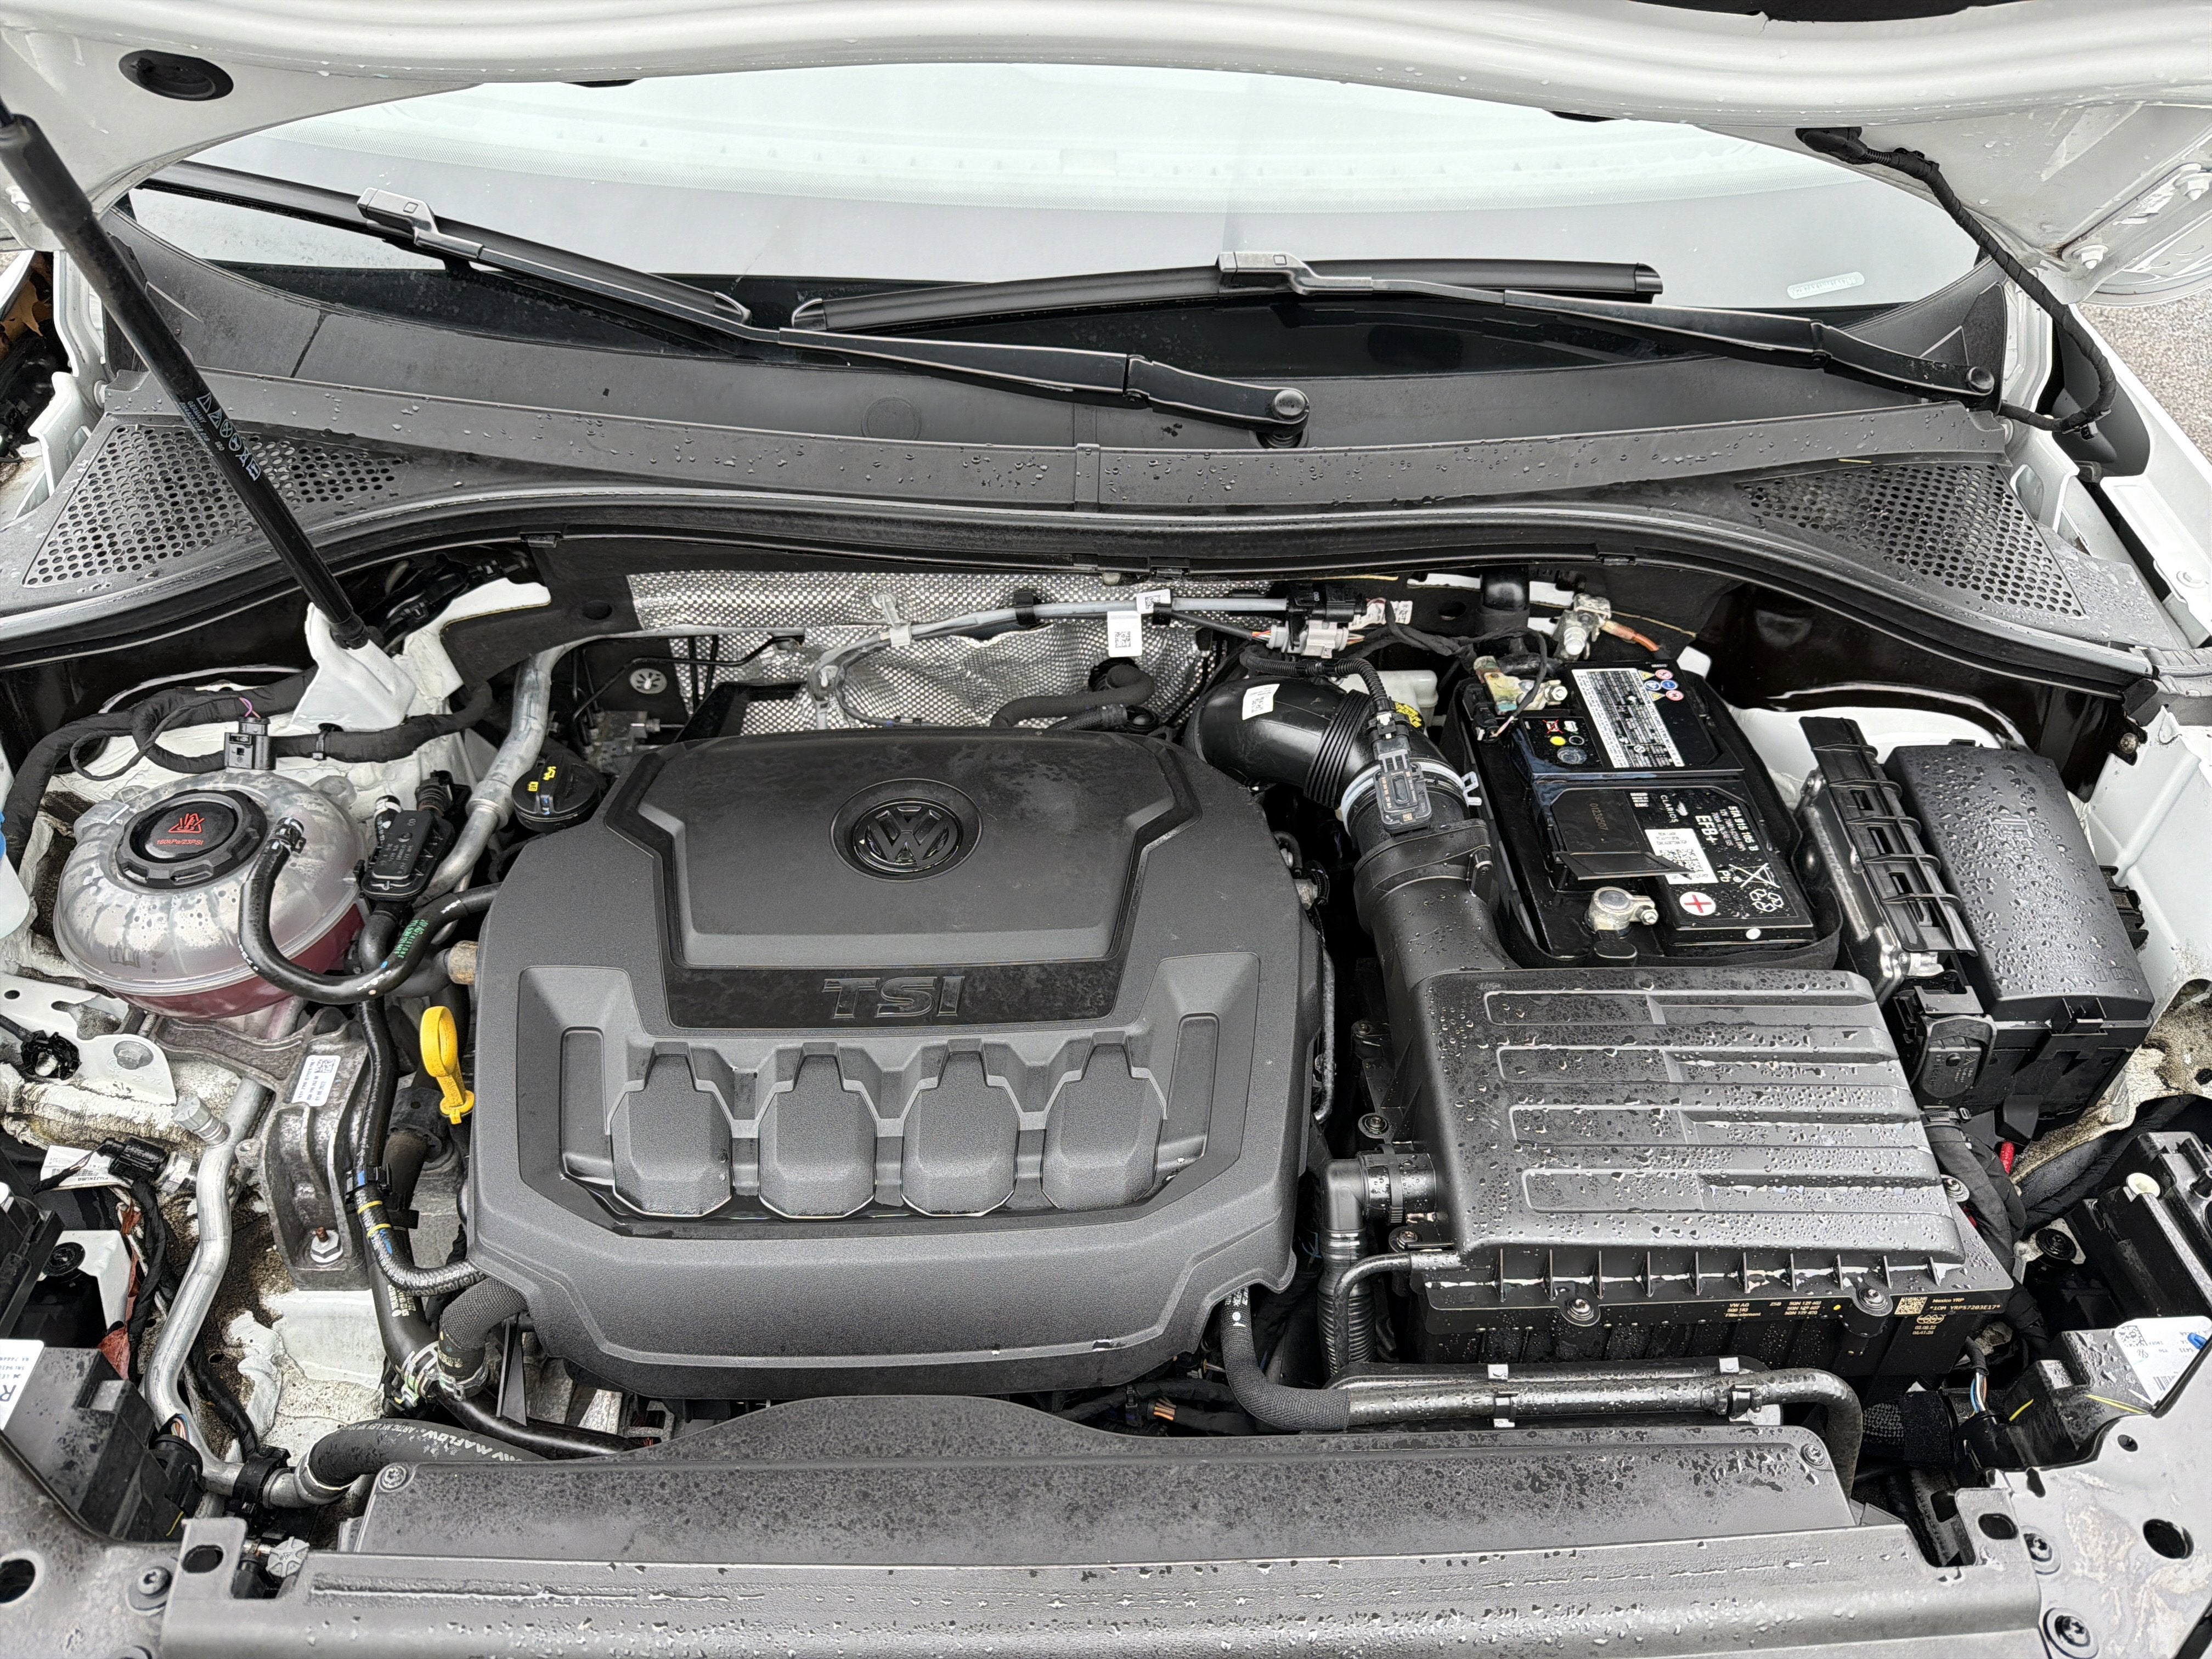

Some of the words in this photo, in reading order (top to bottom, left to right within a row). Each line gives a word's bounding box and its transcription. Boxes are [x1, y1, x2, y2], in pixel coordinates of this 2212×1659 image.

[187, 400, 206, 424] GERMANY
[1589, 803, 1609, 831] 01239507
[1660, 794, 1679, 823] CLARIOS
[1728, 806, 1742, 818] 5TA
[1695, 815, 1719, 844] EFB+
[1734, 817, 1748, 831] 915
[1741, 831, 1754, 843] 105
[1717, 869, 1730, 883] Pb
[398, 931, 417, 959] TRISTONE
[822, 975, 966, 1019] TSI
[0, 1384, 17, 1402] R
[421, 1430, 493, 1455] MAFLOW
